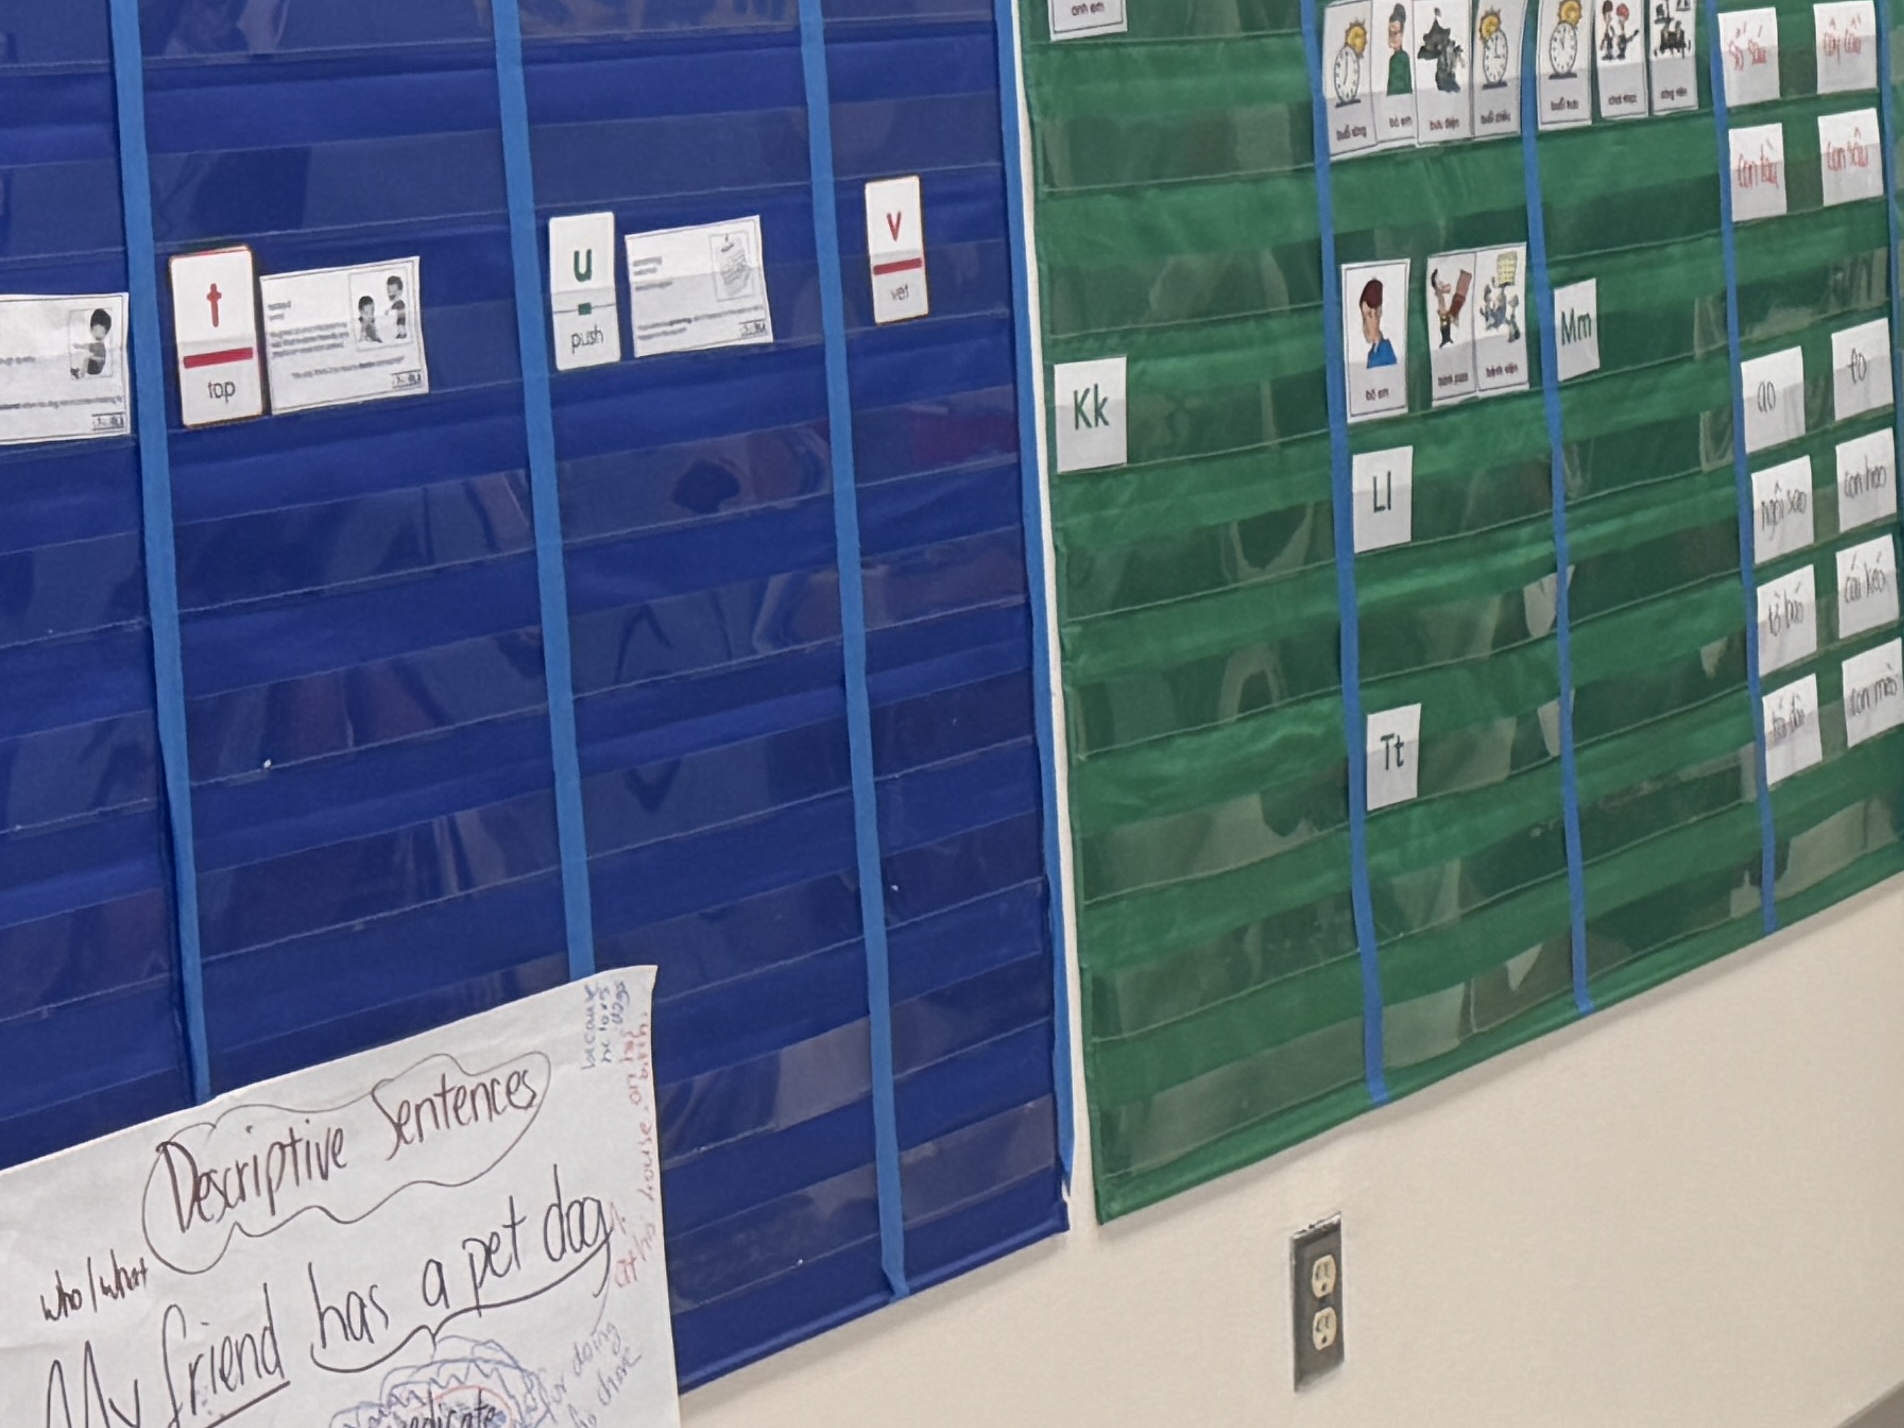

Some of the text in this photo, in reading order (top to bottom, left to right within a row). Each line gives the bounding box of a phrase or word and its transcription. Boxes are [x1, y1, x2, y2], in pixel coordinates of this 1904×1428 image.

[886, 211, 901, 242] v
[573, 249, 592, 282] u
[206, 283, 222, 328] t
[571, 324, 604, 354] push
[1561, 309, 1593, 347] Mm
[208, 381, 236, 403] top
[1073, 383, 1109, 431] Kk
[1380, 733, 1405, 772] Tt
[156, 1067, 538, 1232] Descriptive Sentences
[309, 1262, 389, 1350] has
[421, 1258, 450, 1307] a
[462, 1195, 527, 1316] pet
[542, 1164, 616, 1299] dog
